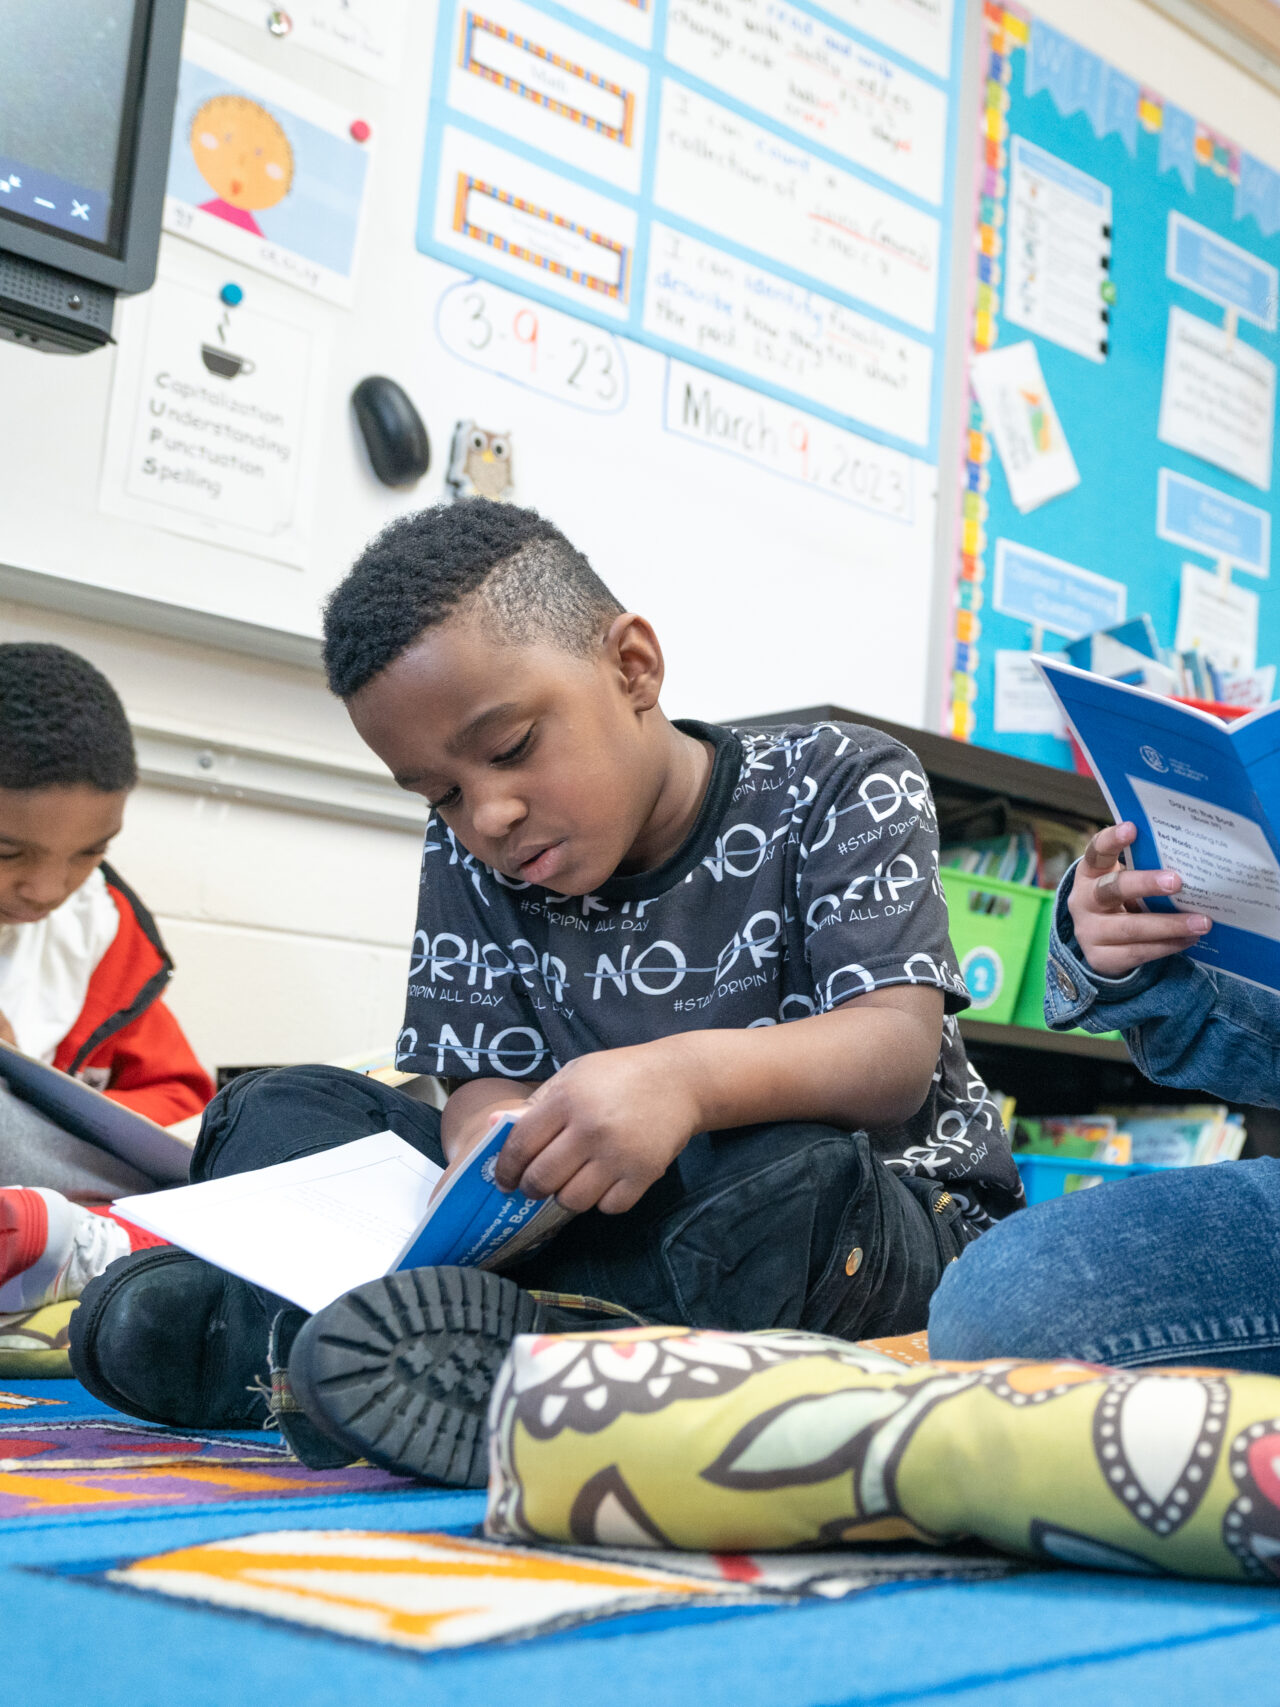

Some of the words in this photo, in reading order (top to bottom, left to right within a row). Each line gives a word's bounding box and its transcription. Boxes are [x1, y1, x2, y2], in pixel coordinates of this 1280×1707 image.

[156, 371, 286, 429] Capitalization
[149, 398, 292, 463] Understanding
[148, 427, 267, 478] Punctuation
[682, 382, 778, 458] March
[830, 444, 907, 514] 2023
[141, 456, 222, 499] Spelling
[1168, 799, 1186, 812] Day
[1199, 809, 1213, 819] the
[1215, 815, 1235, 828] Boat
[837, 826, 883, 856] #STAY
[1157, 830, 1170, 841] Red
[1184, 828, 1216, 846] doubling
[550, 912, 590, 932] RIPIN
[595, 920, 615, 933] ALL
[621, 919, 650, 932] DAY
[849, 908, 879, 922] ALL
[884, 901, 915, 916] DAY
[593, 940, 687, 1000] NO
[974, 966, 989, 992] 2
[439, 989, 464, 1003] ALL
[470, 991, 503, 1008] DAY
[673, 989, 716, 1013] #STAY
[718, 972, 768, 999] DRIPIN
[437, 1023, 544, 1077] NO
[970, 1142, 989, 1166] DAY
[508, 1198, 538, 1224] Boa
